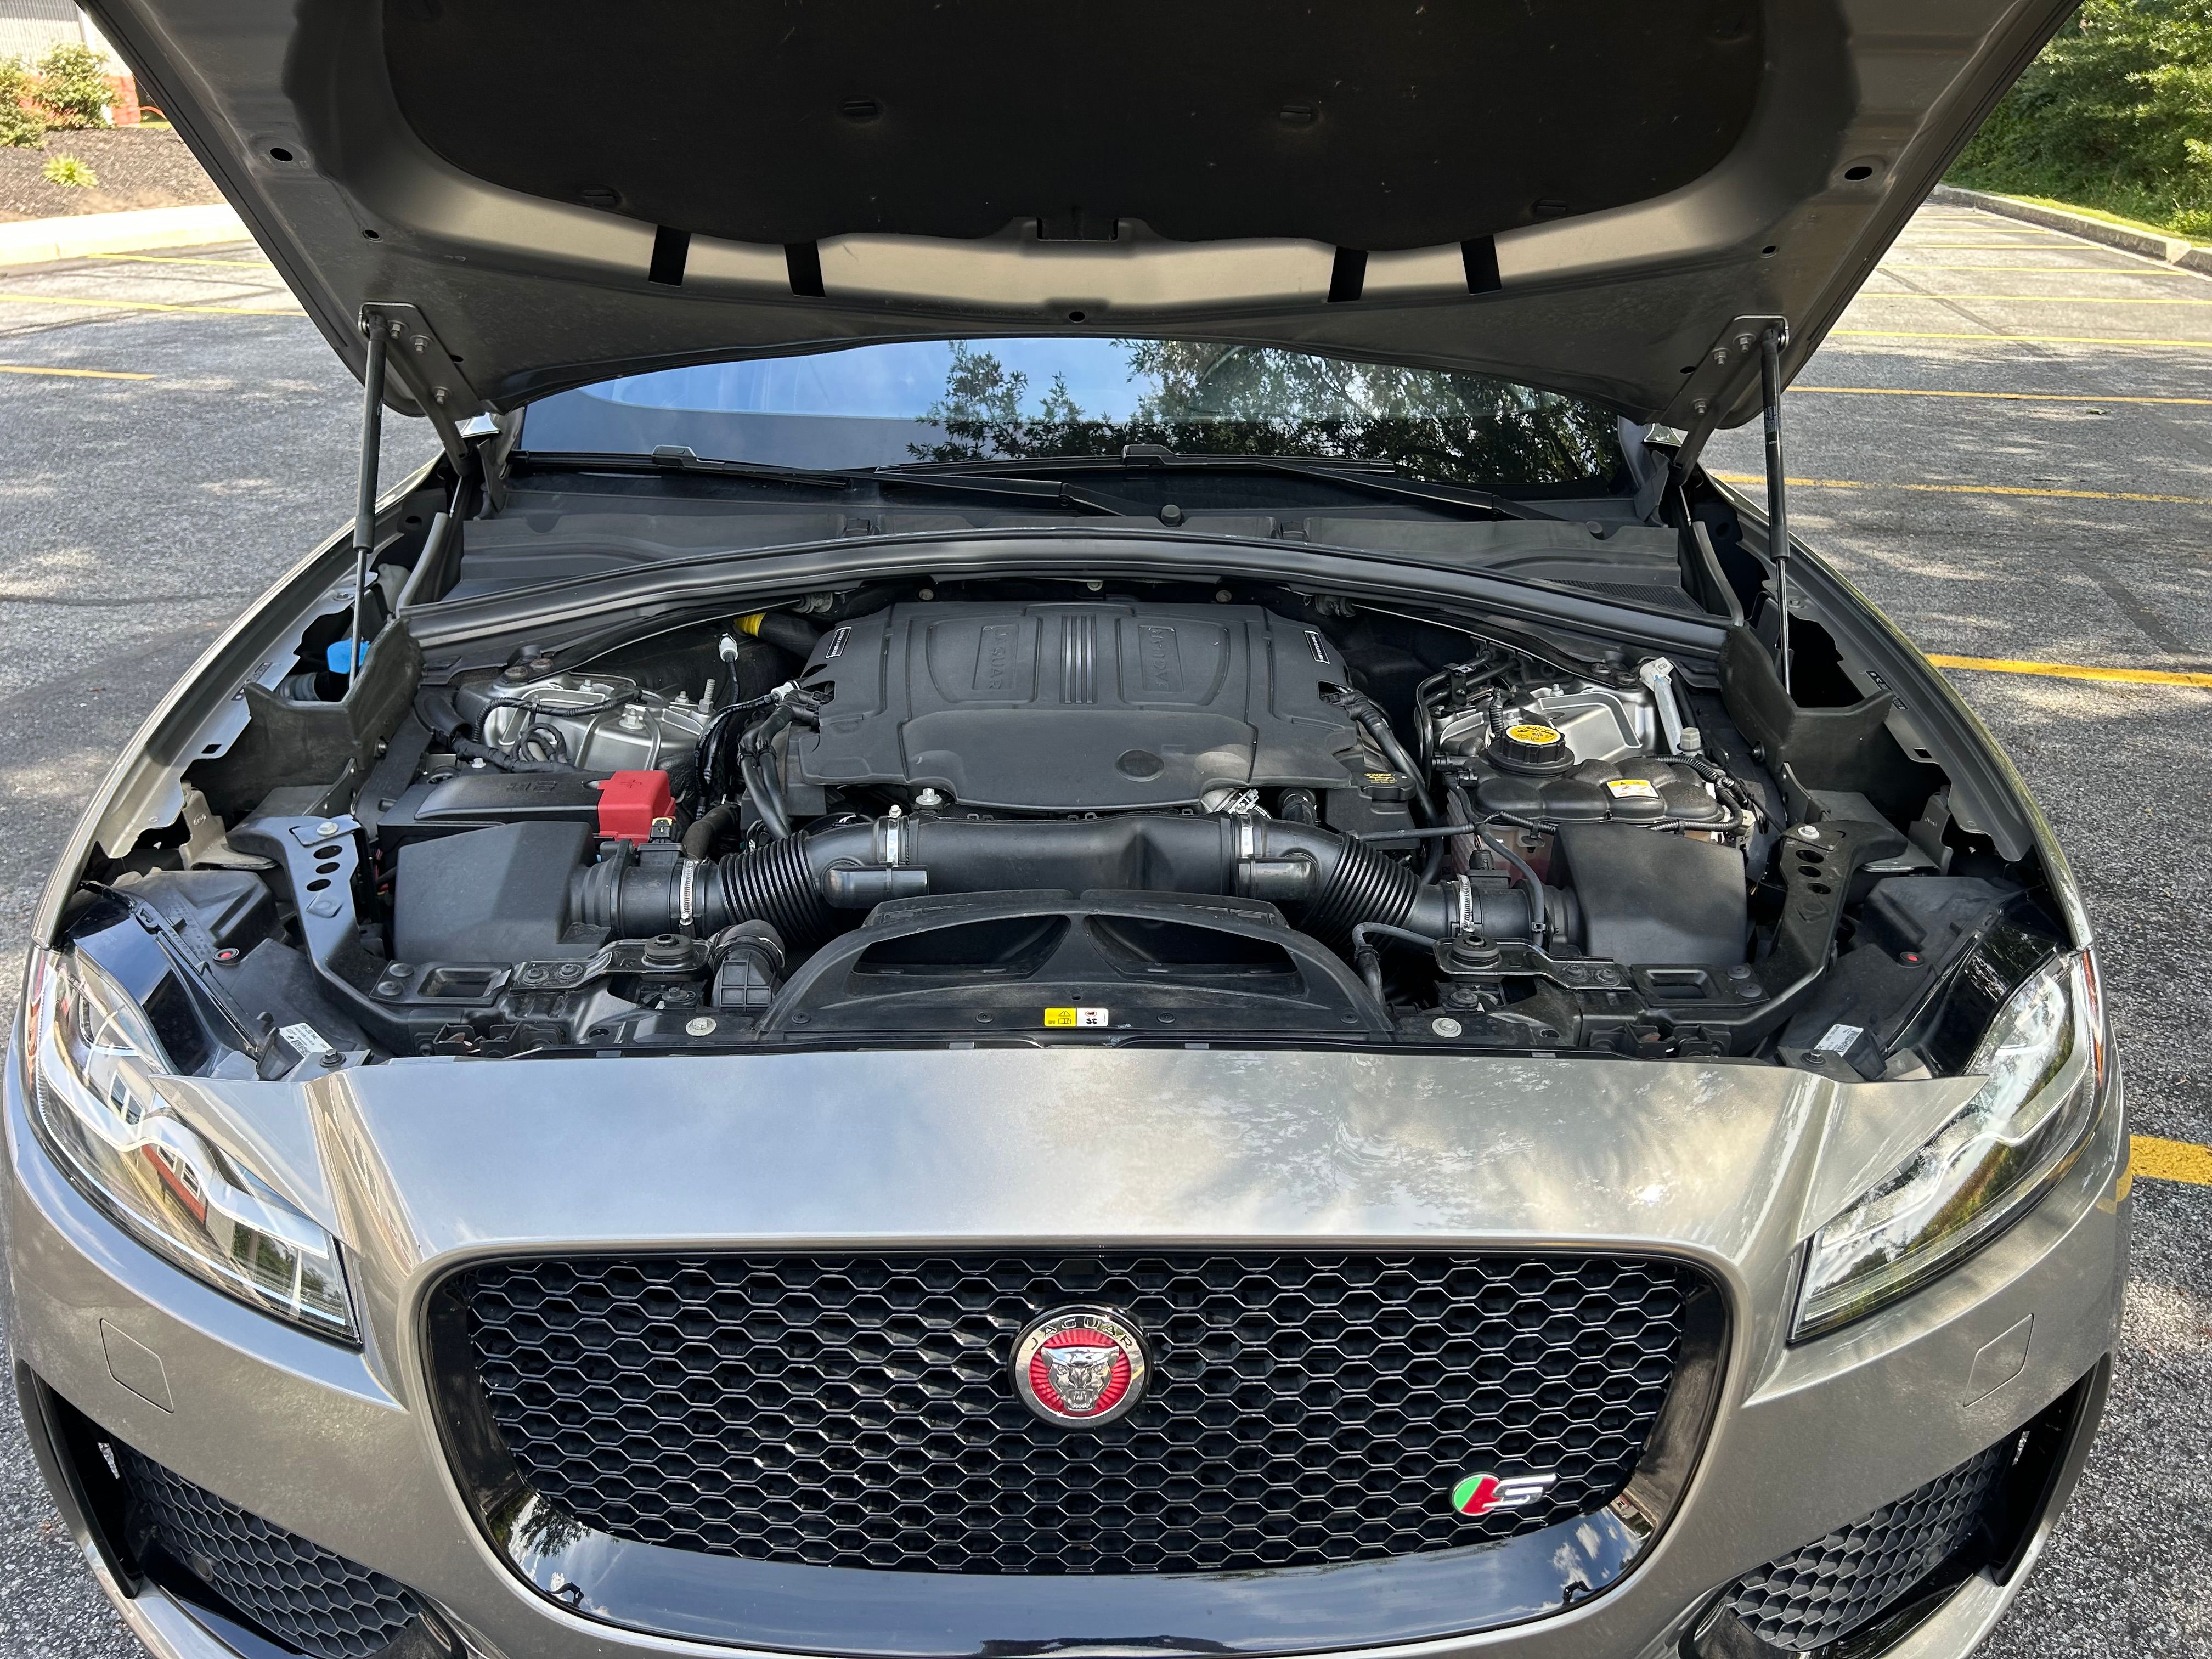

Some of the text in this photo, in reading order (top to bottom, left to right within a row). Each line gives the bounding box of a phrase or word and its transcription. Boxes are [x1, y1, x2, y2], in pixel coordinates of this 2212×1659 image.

[988, 627, 1008, 690] JAGUAR
[1149, 629, 1169, 691] JAGUAR
[1031, 1317, 1135, 1351] JAGUAR
